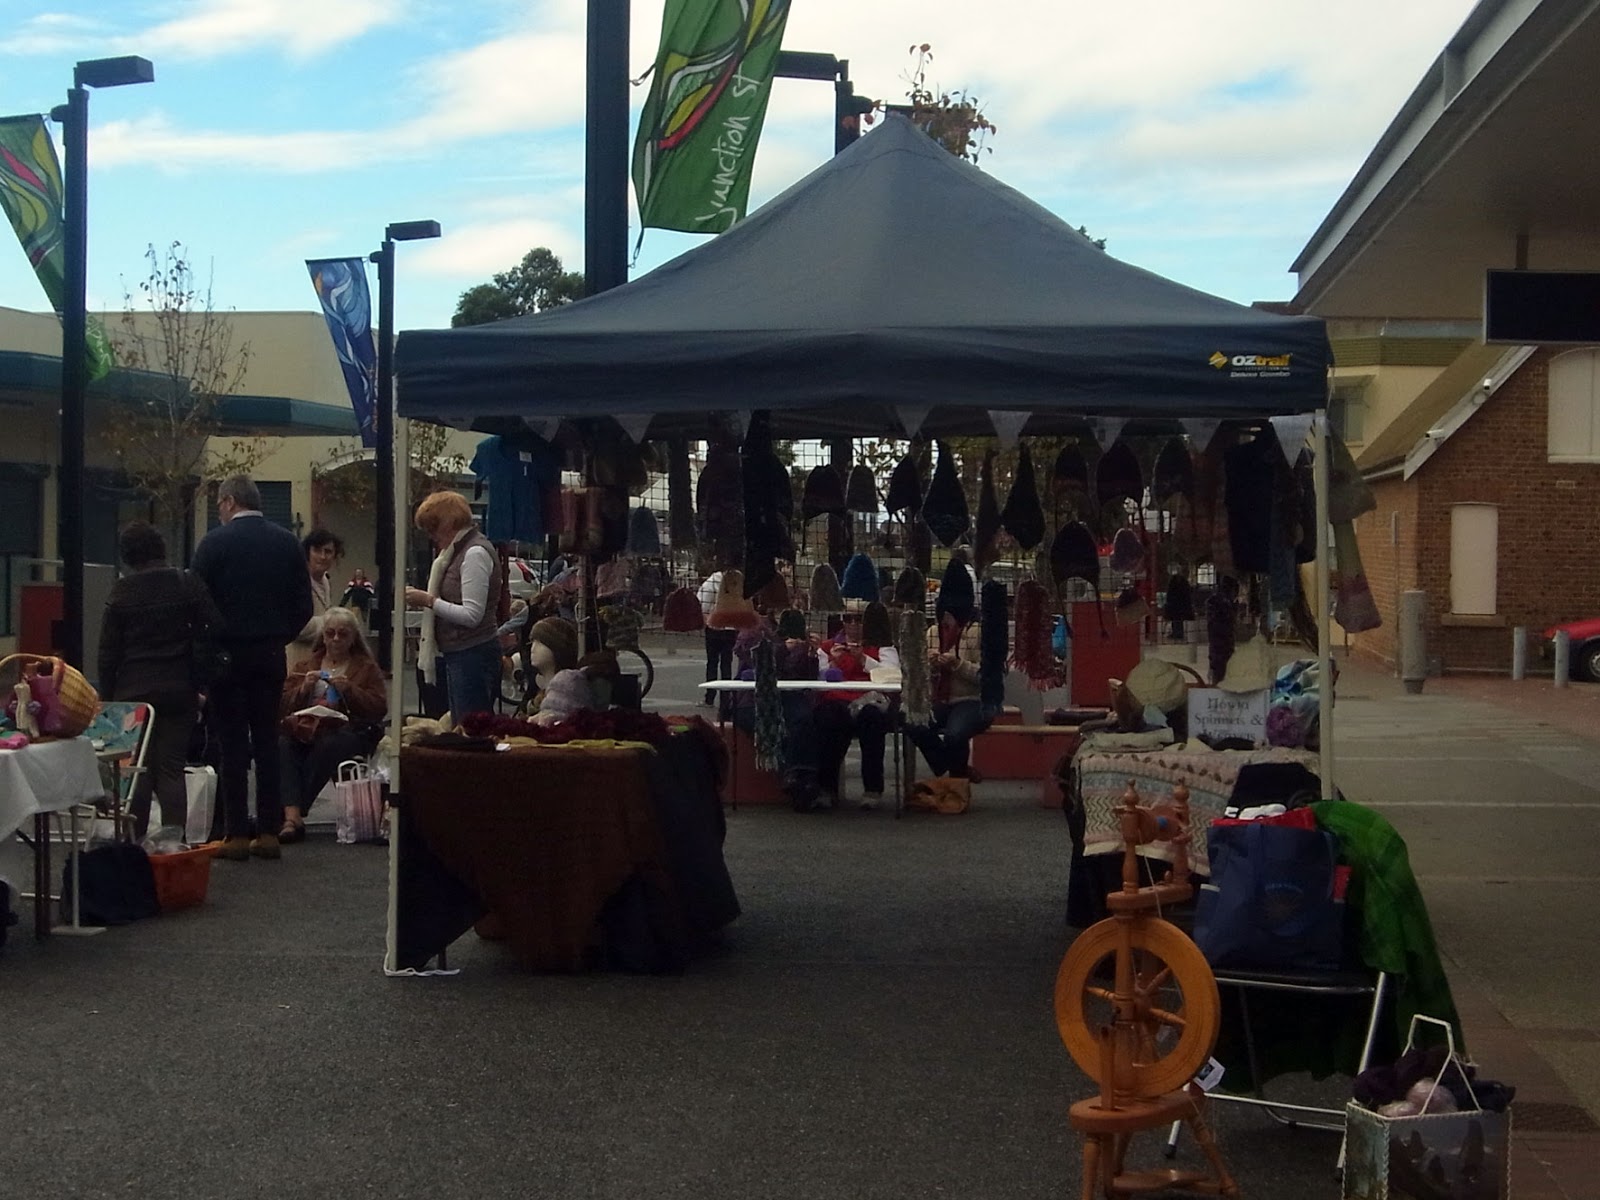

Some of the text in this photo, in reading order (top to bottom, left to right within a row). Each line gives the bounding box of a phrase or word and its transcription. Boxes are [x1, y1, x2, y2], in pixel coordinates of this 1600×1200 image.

[695, 61, 762, 226] Junction St
[1250, 714, 1264, 726] &
